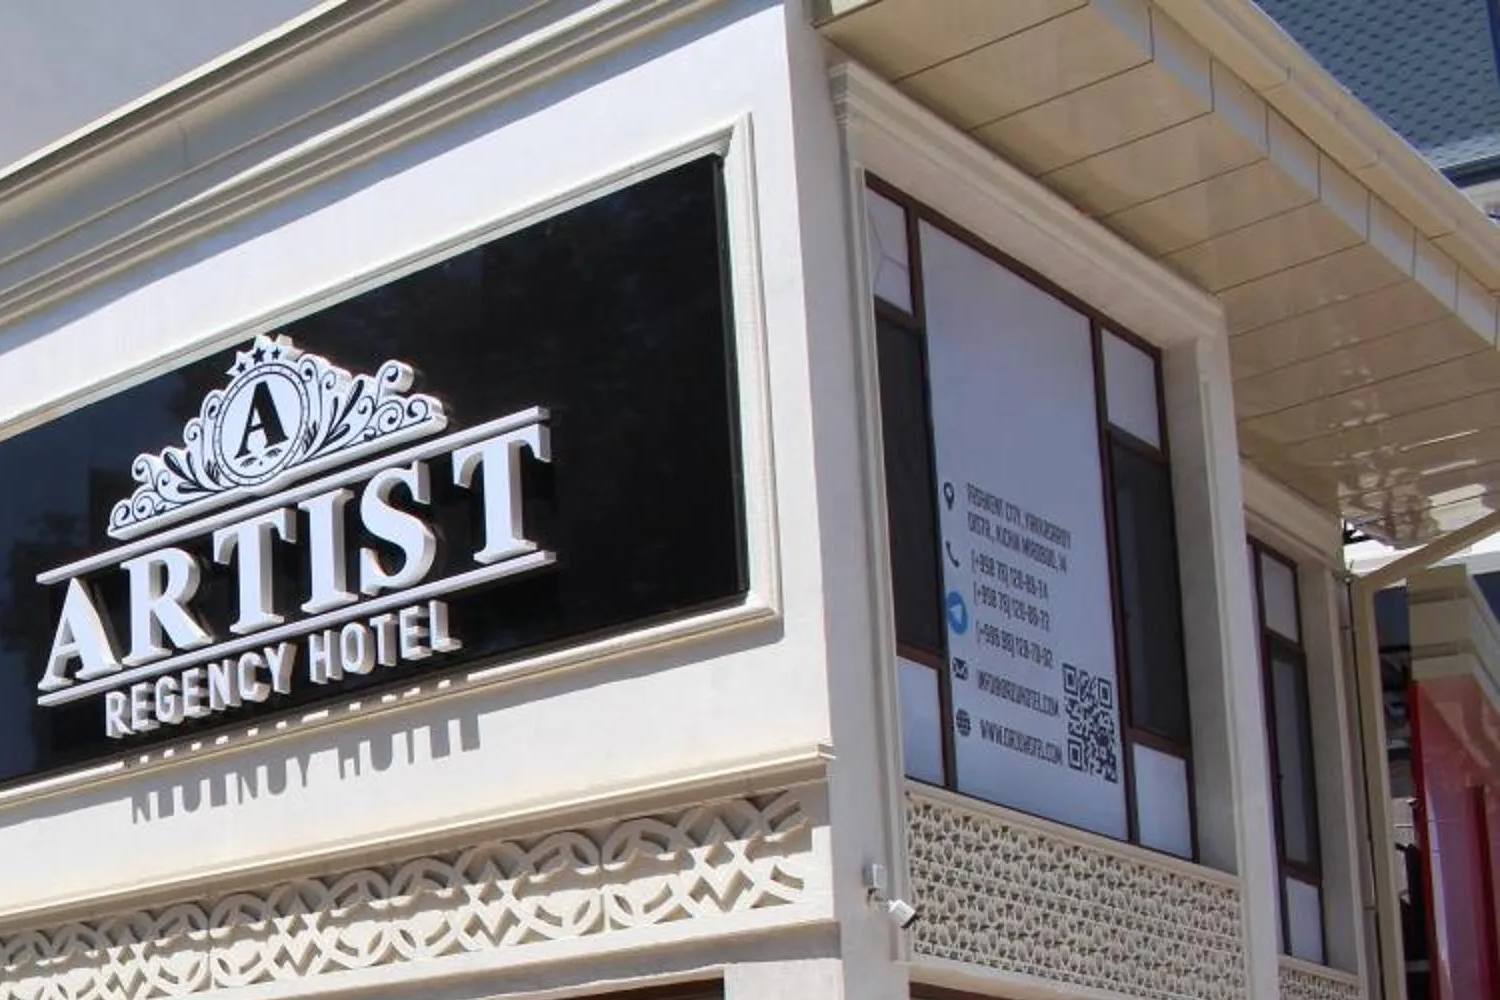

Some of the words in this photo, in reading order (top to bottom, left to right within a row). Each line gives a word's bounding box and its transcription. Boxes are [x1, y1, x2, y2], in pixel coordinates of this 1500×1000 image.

[235, 379, 288, 460] A
[37, 422, 551, 691] ARTIST
[104, 641, 298, 738] REGENCY
[308, 600, 462, 685] HOTEL
